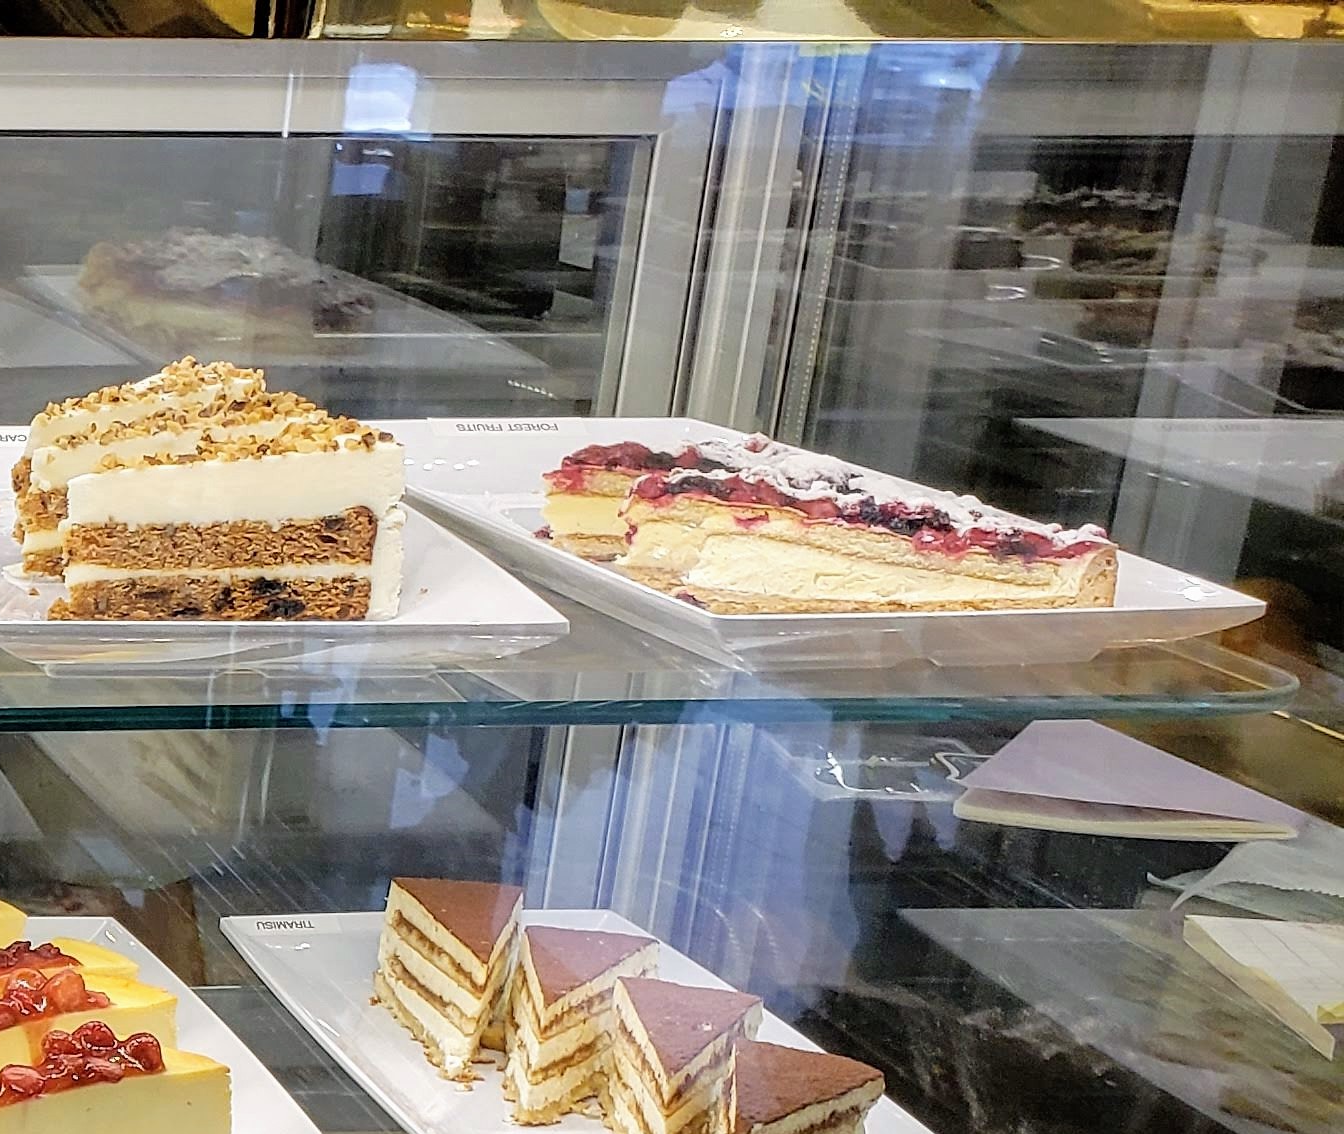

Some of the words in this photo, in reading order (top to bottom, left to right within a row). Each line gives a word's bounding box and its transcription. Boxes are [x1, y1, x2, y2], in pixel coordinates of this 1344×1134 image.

[456, 423, 503, 432] FRUITS
[506, 423, 559, 432] FOREST
[256, 920, 315, 931] TIRAMISU
